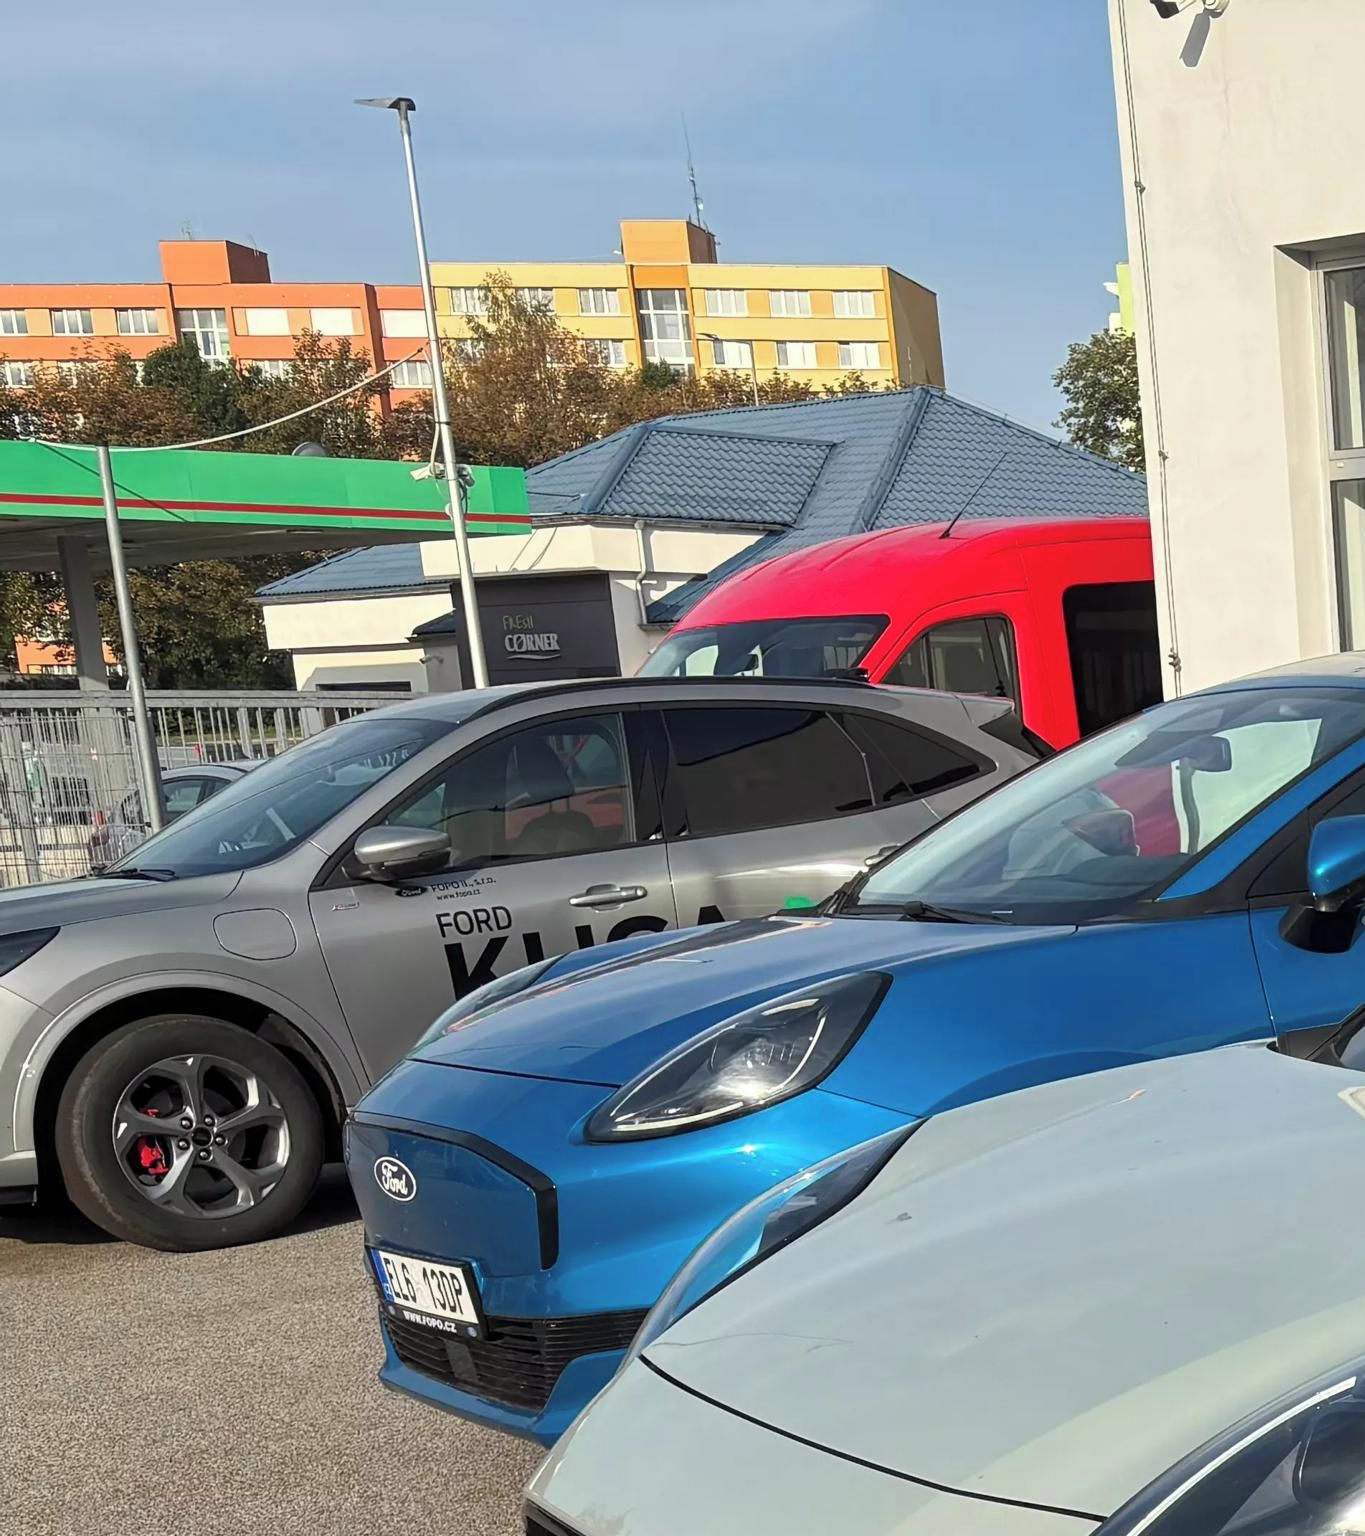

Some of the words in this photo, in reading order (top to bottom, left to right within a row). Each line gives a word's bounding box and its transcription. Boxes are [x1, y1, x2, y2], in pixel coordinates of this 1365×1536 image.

[435, 905, 513, 938] FORD
[381, 1161, 409, 1196] Ford
[383, 1257, 417, 1303] EL6
[422, 1266, 465, 1316] 13DP
[402, 1310, 458, 1333] WWW.FOPO.CZ
